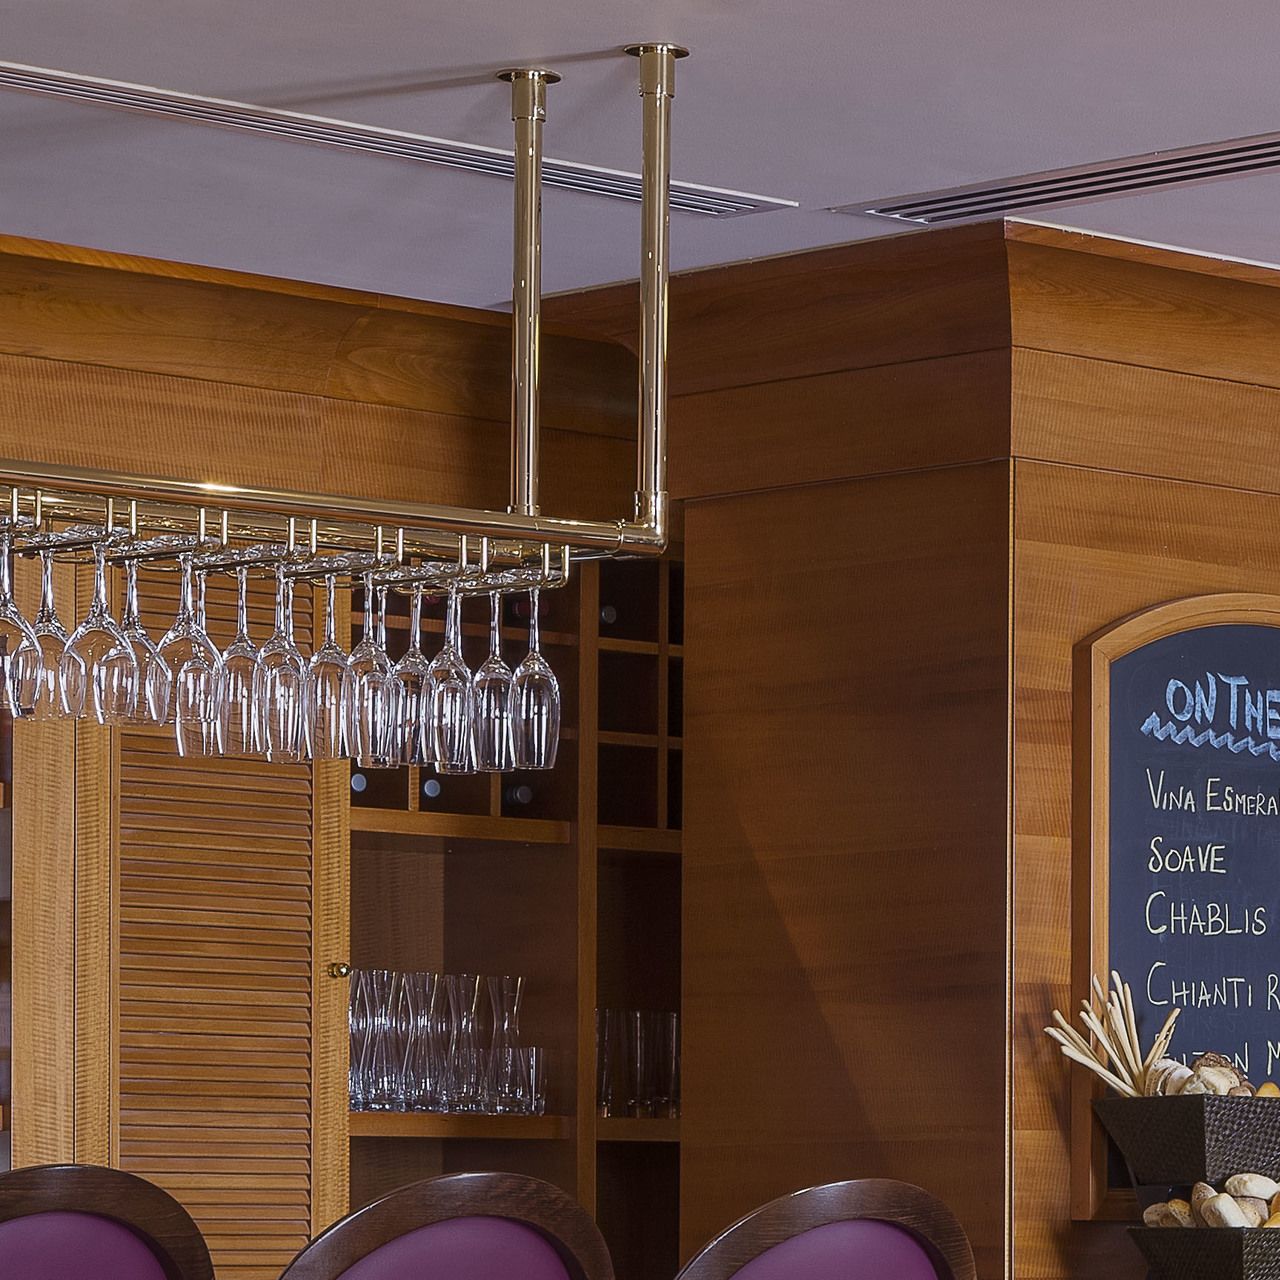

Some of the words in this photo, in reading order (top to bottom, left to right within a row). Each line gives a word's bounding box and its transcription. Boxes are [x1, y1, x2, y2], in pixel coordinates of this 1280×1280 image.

[1166, 671, 1217, 724] ON
[1147, 768, 1196, 813] VINA
[1148, 836, 1227, 874] SOAVE
[1145, 891, 1267, 936] CHABLIS
[1147, 962, 1253, 1008] CHIANTI
